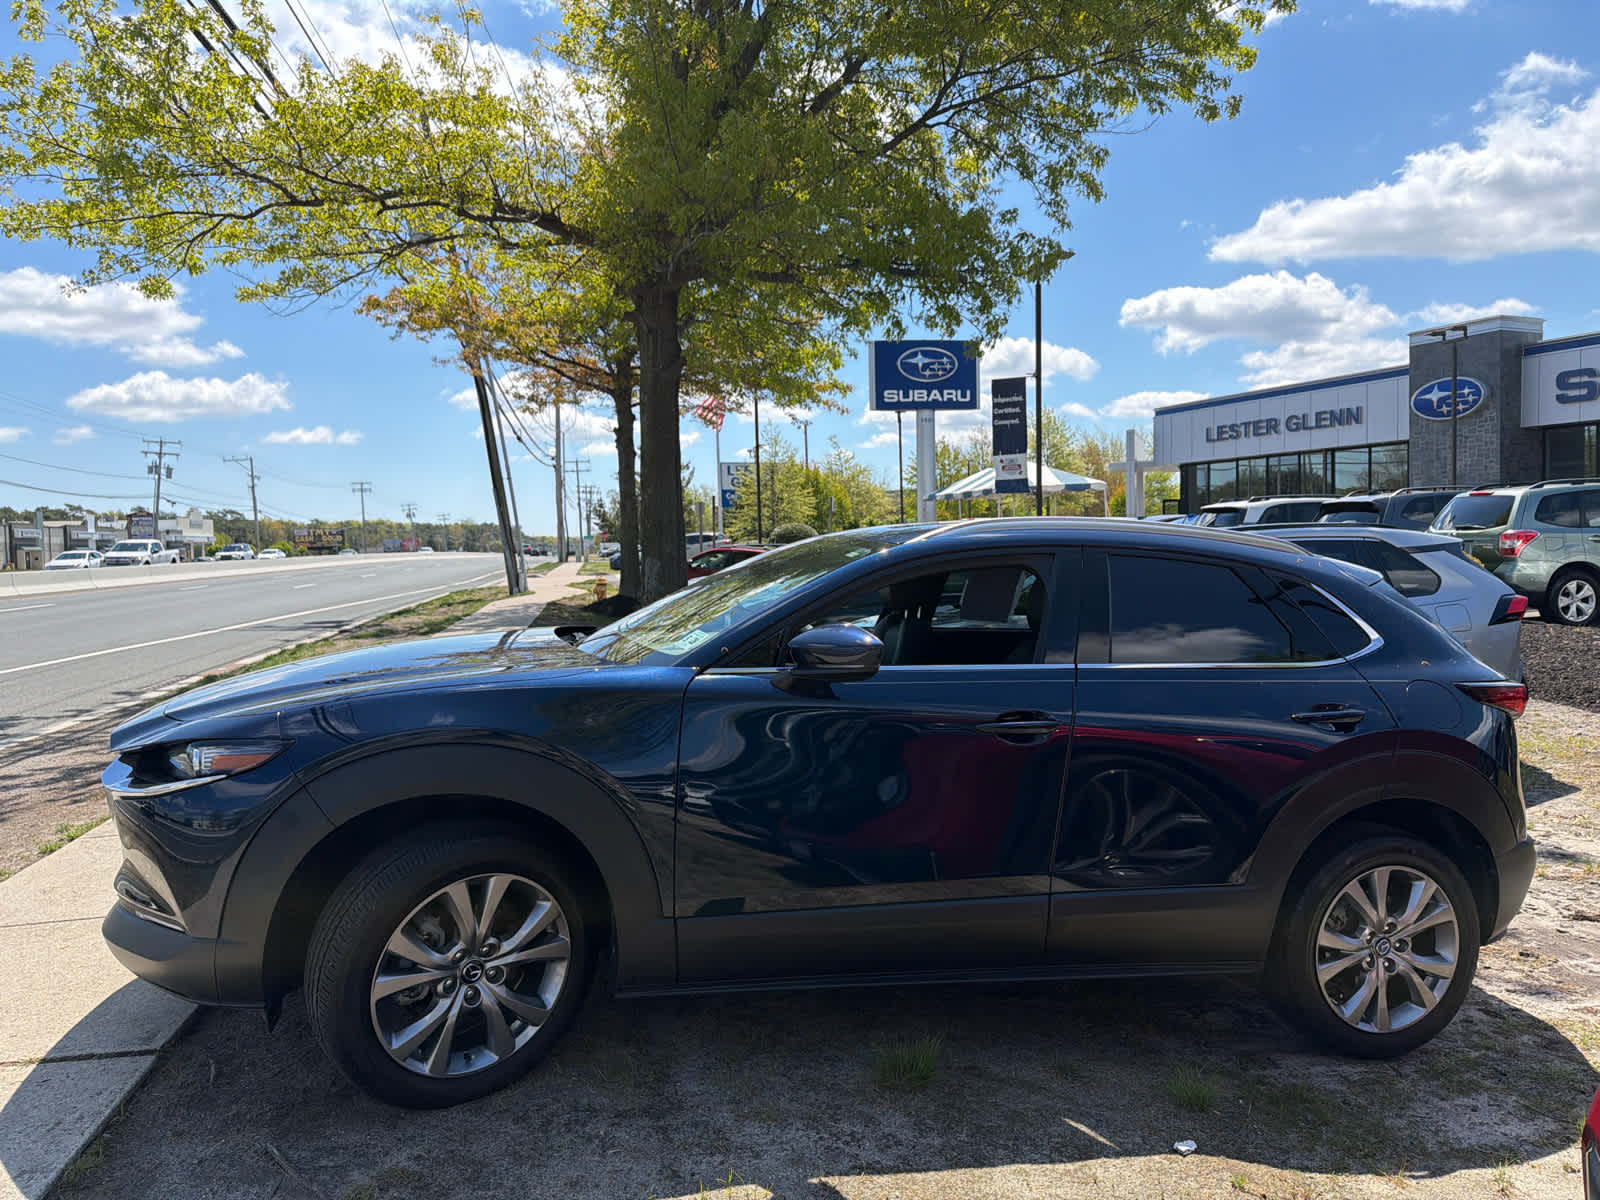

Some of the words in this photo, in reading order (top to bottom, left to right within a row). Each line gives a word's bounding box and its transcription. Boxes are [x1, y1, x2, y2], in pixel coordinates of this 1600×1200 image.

[883, 389, 971, 403] SUBARU
[1206, 418, 1281, 443] LESTER
[1285, 406, 1363, 433] GLENN
